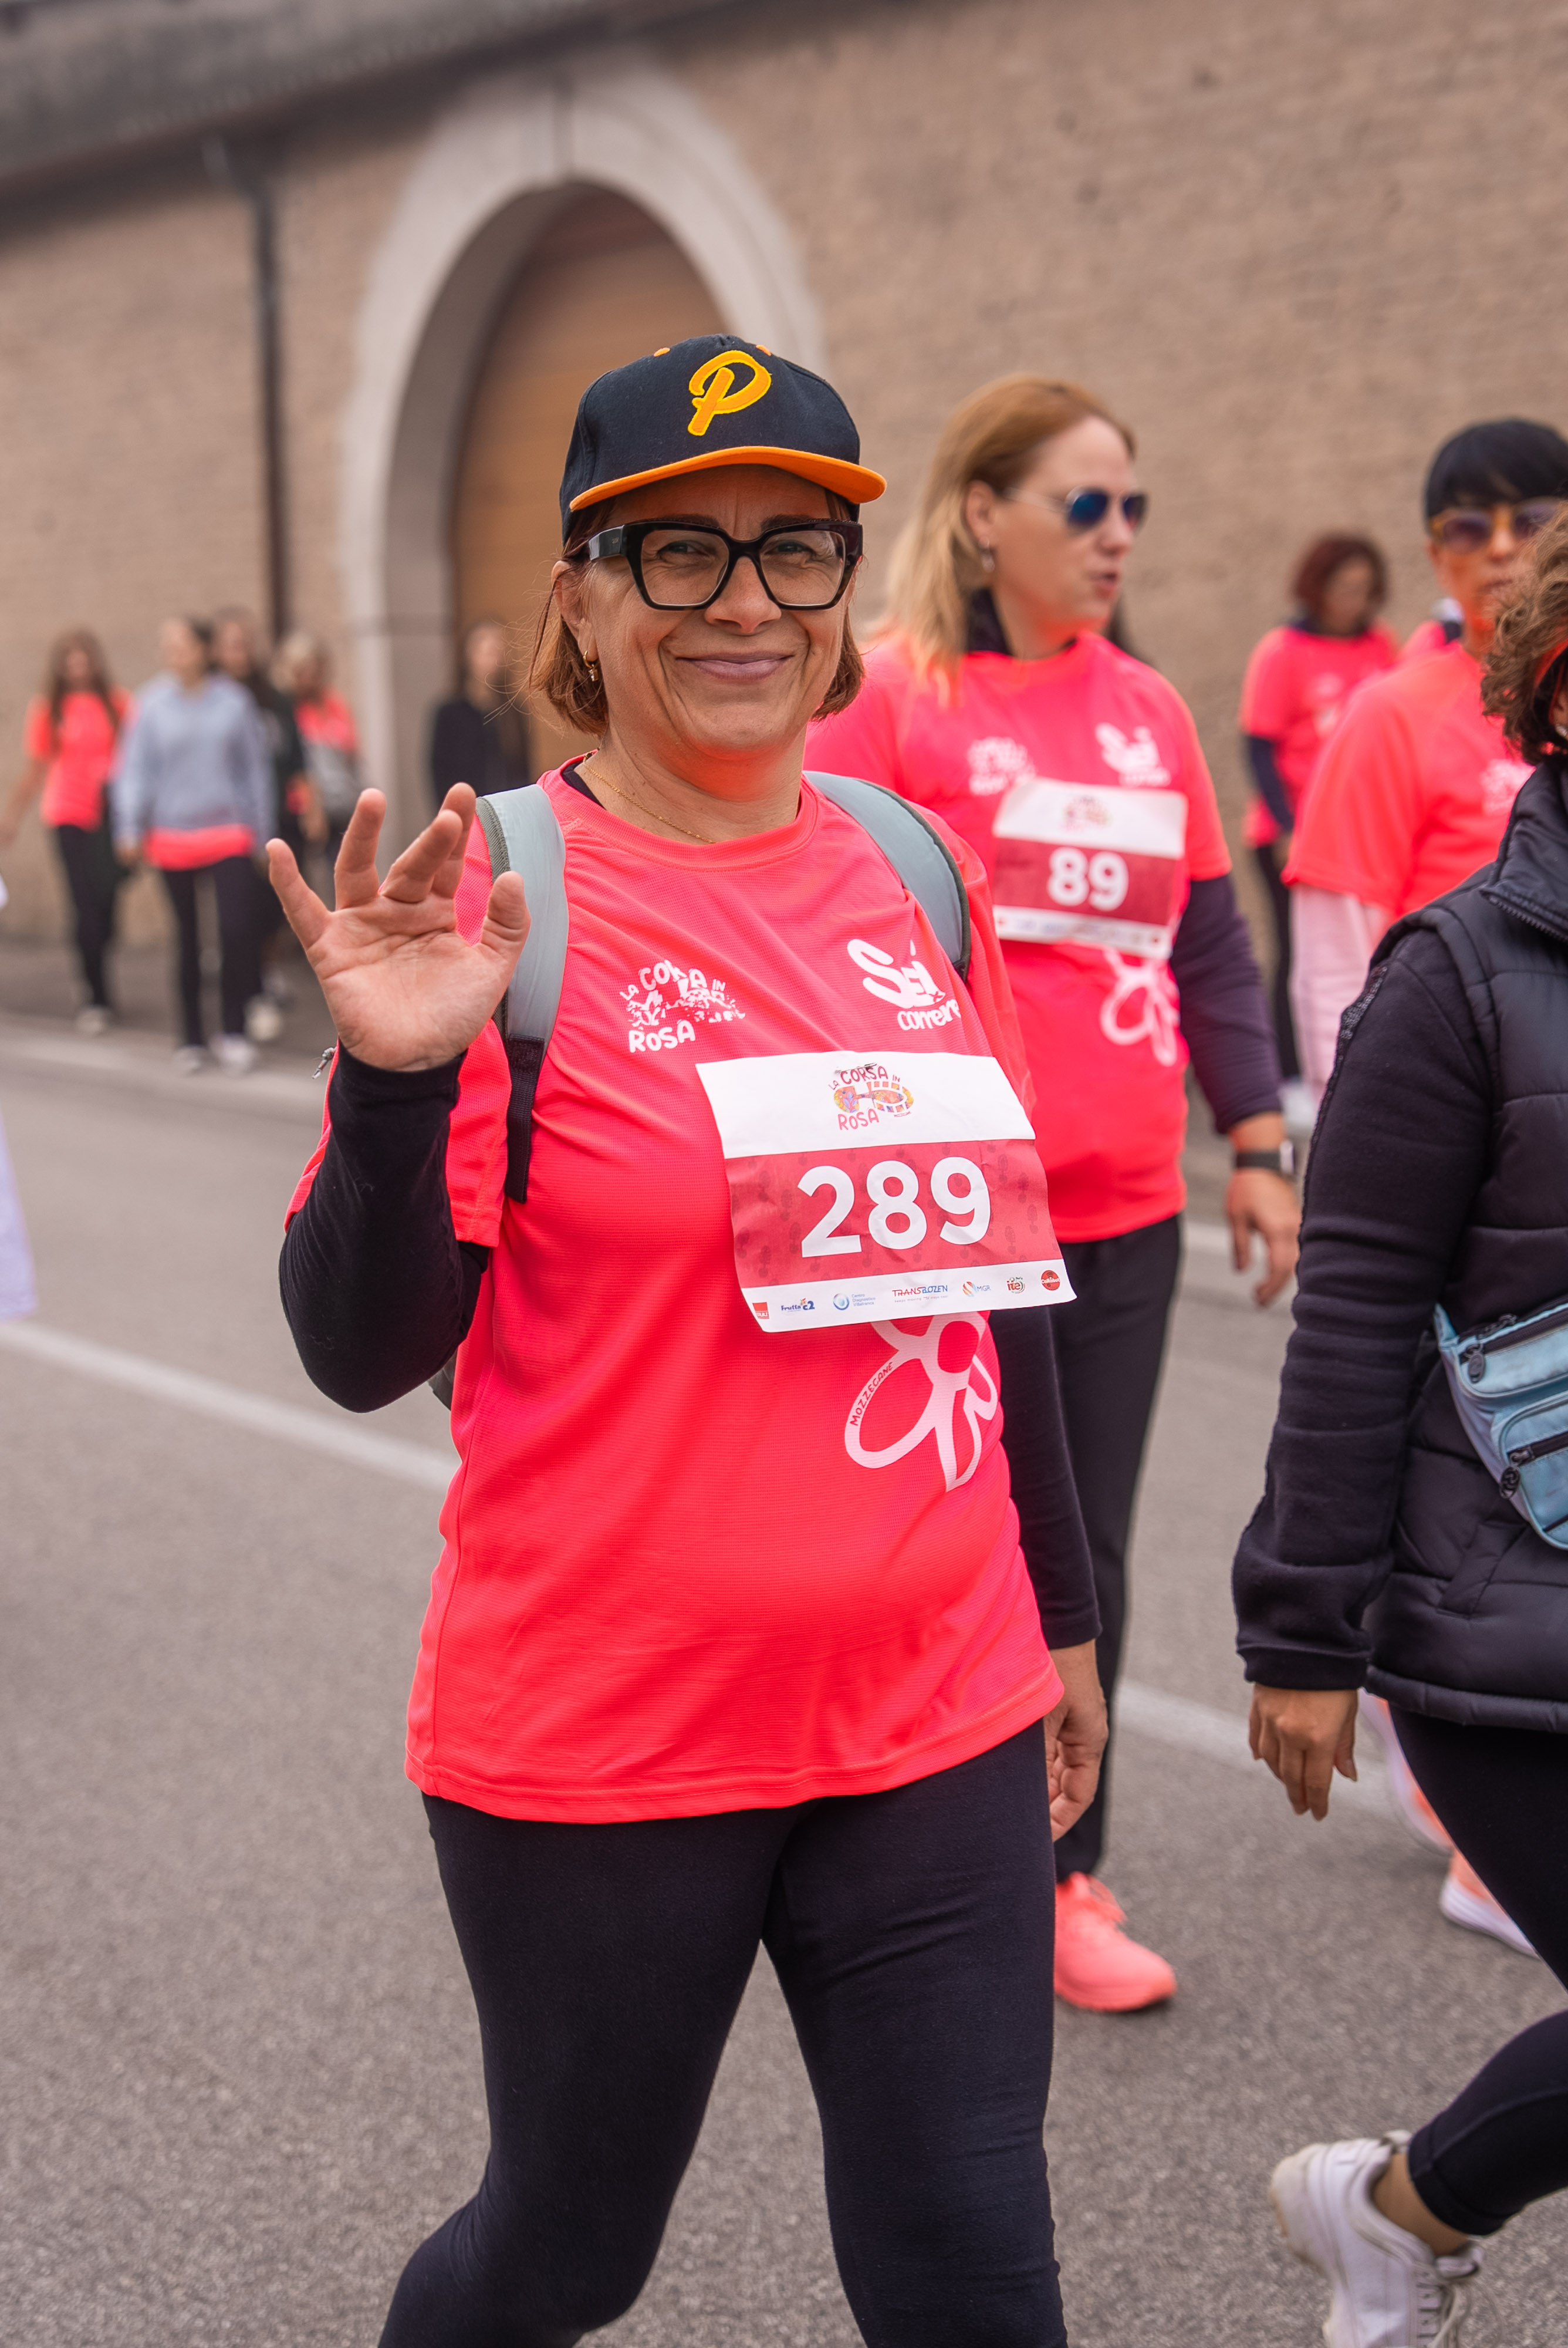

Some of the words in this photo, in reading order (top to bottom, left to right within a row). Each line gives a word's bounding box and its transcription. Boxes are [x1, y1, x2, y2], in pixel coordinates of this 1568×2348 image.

[688, 350, 771, 436] P
[1047, 846, 1129, 912] 89
[620, 984, 639, 1000] LA
[712, 979, 726, 991] IN
[628, 1019, 695, 1052] ROSA
[828, 1080, 840, 1090] LA
[840, 1065, 888, 1084] CORSA
[892, 1074, 900, 1082] IN
[837, 1108, 879, 1131] ROSA
[797, 1156, 991, 1258] 289
[892, 1284, 948, 1296] TRANSBOZEN
[850, 1362, 893, 1426] MOZZECANE
